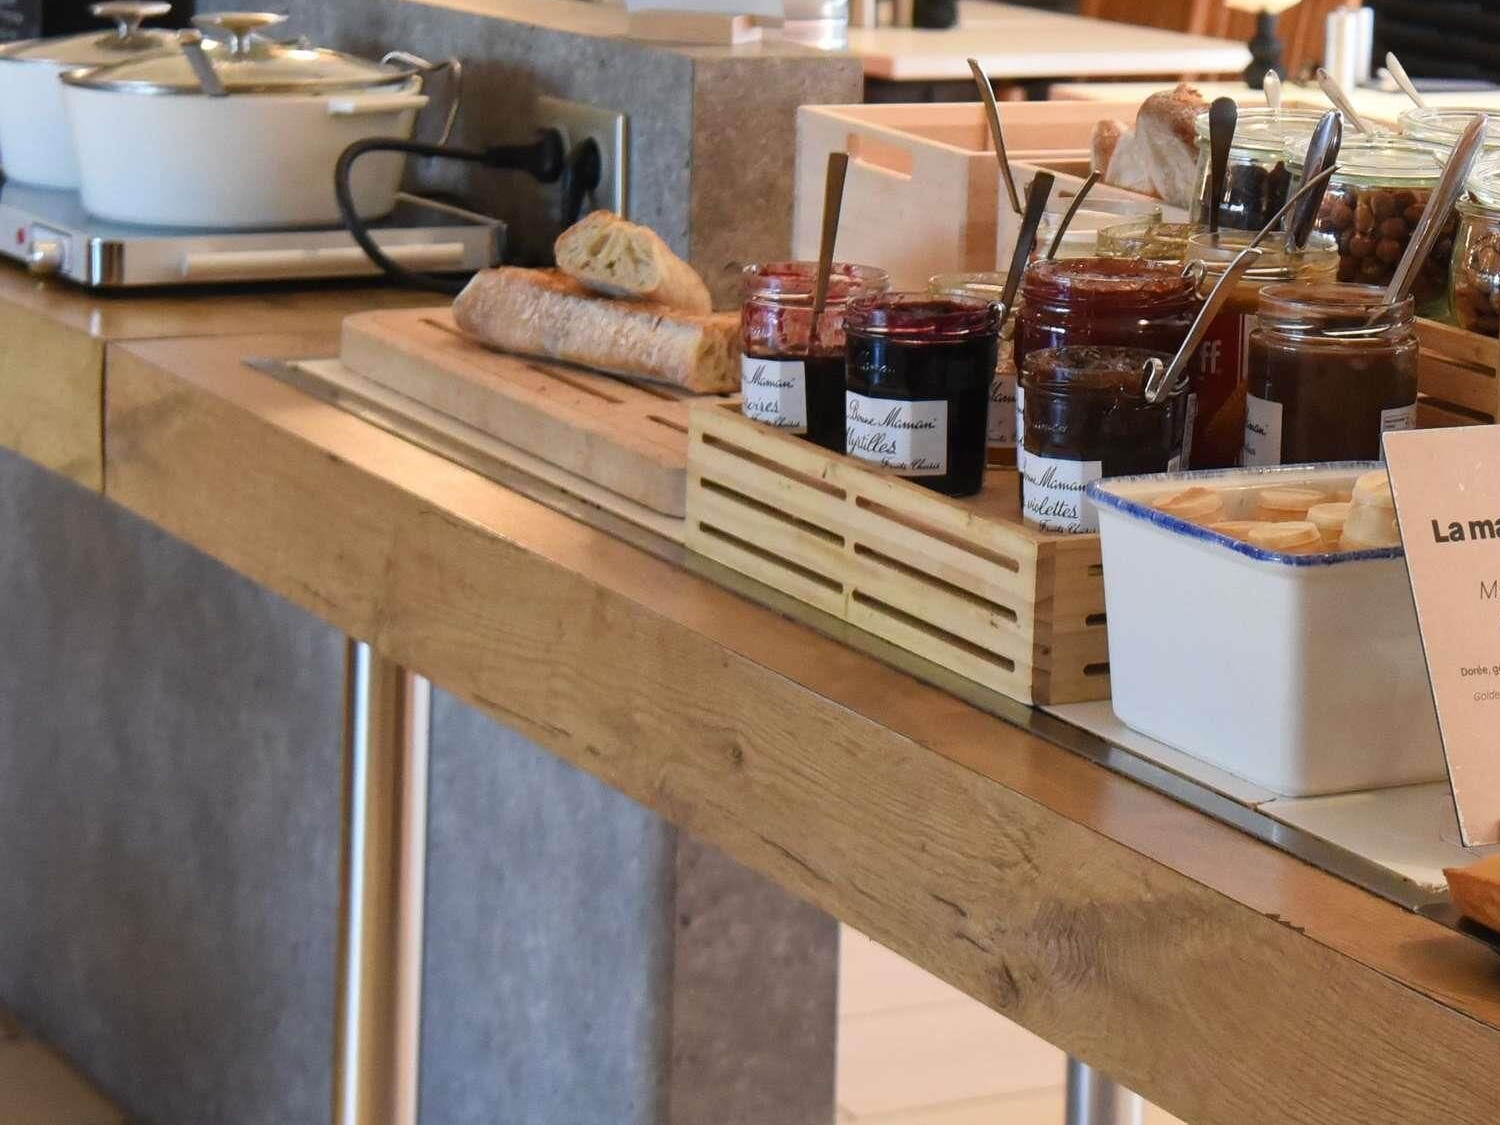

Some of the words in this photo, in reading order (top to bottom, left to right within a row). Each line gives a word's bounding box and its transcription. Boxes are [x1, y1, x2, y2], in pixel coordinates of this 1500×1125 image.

[848, 399, 877, 427] Bonne
[879, 407, 937, 430] Maman
[1040, 466, 1087, 492] Maman
[1027, 496, 1080, 519] violettes
[1431, 519, 1466, 543] La
